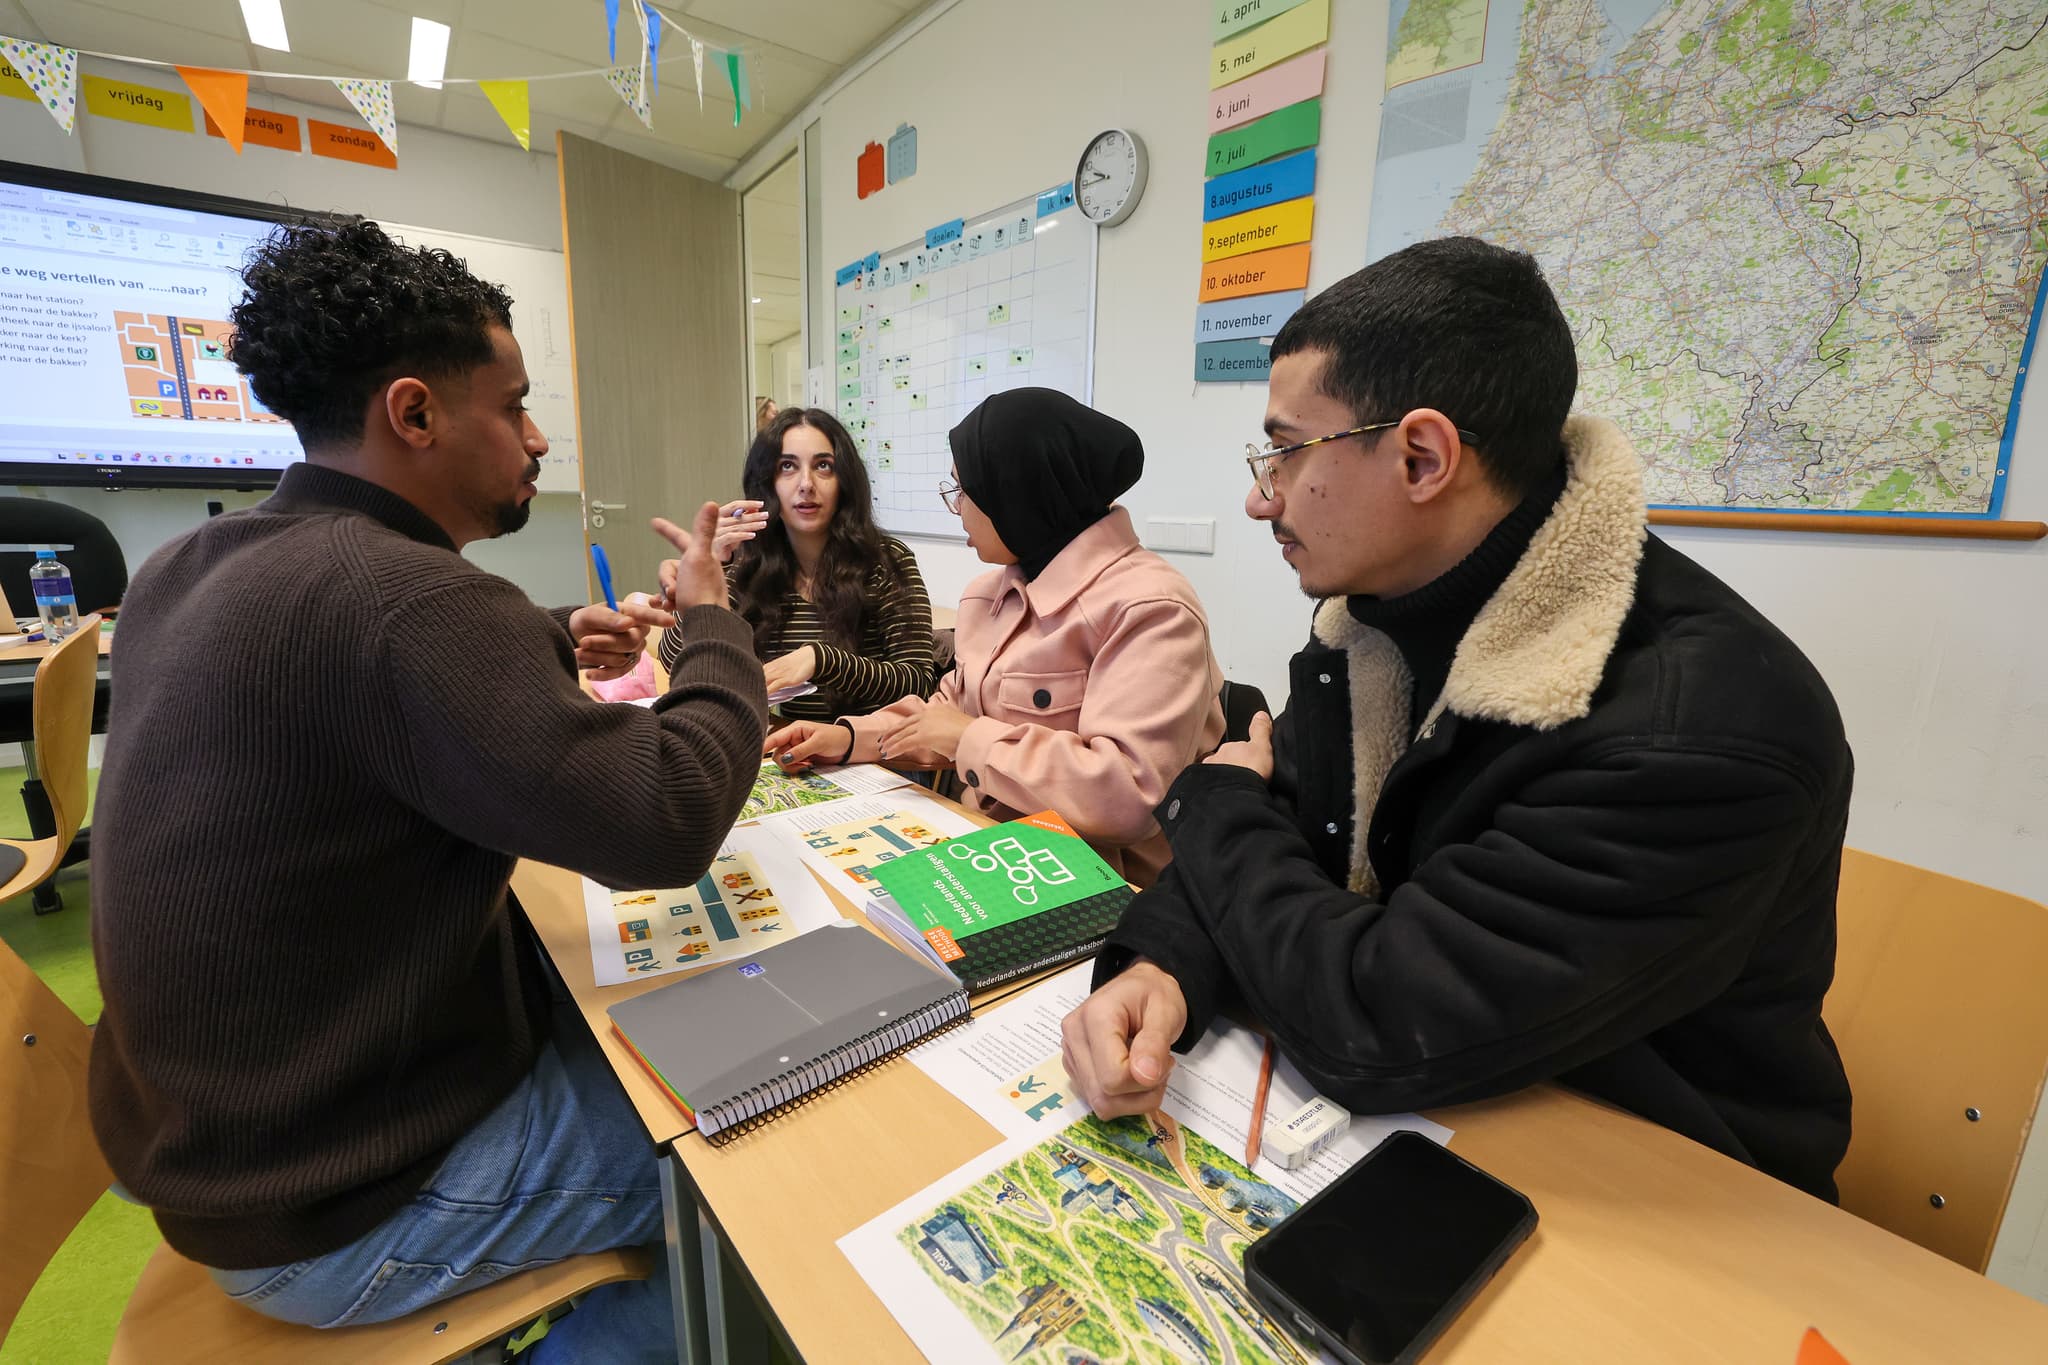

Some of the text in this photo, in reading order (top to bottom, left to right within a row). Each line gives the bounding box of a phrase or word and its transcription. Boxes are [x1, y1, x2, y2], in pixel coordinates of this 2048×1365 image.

[1221, 0, 1261, 24] 4. april
[1220, 47, 1256, 73] 5. mei
[108, 89, 164, 111] vrijdag
[1216, 94, 1250, 119] 6. juni
[245, 117, 283, 134] erdag
[330, 133, 375, 151] zondag
[1215, 144, 1246, 164] 7. juli
[0, 265, 11, 275] e
[15, 267, 47, 281] weg
[51, 271, 115, 287] vertellen
[119, 280, 144, 290] van
[1206, 270, 1266, 290] 10. oktober
[0, 292, 84, 305] naar het station?
[21, 306, 42, 314] naar
[61, 310, 98, 319] bakker?
[1202, 313, 1272, 332] 11. november
[32, 320, 54, 328] naar
[57, 321, 69, 329] de
[72, 322, 112, 332] ijssalon?
[21, 331, 42, 340] naar
[61, 334, 87, 343] kerk?
[52, 345, 65, 353] de
[50, 358, 87, 367] bakker?
[1203, 358, 1216, 371] 12.
[162, 383, 174, 395] P
[926, 853, 973, 900] anderstaligen
[933, 879, 974, 925] Nederlands
[969, 901, 988, 920] voor
[928, 931, 952, 959] DELFTSE
[936, 928, 960, 956] METHODE
[976, 969, 1016, 988] Nederlands
[1017, 963, 1032, 975] voor
[1033, 948, 1077, 969] anderstaligen
[1292, 1103, 1325, 1127] STAEDTLER
[932, 1247, 953, 1271] ASML
